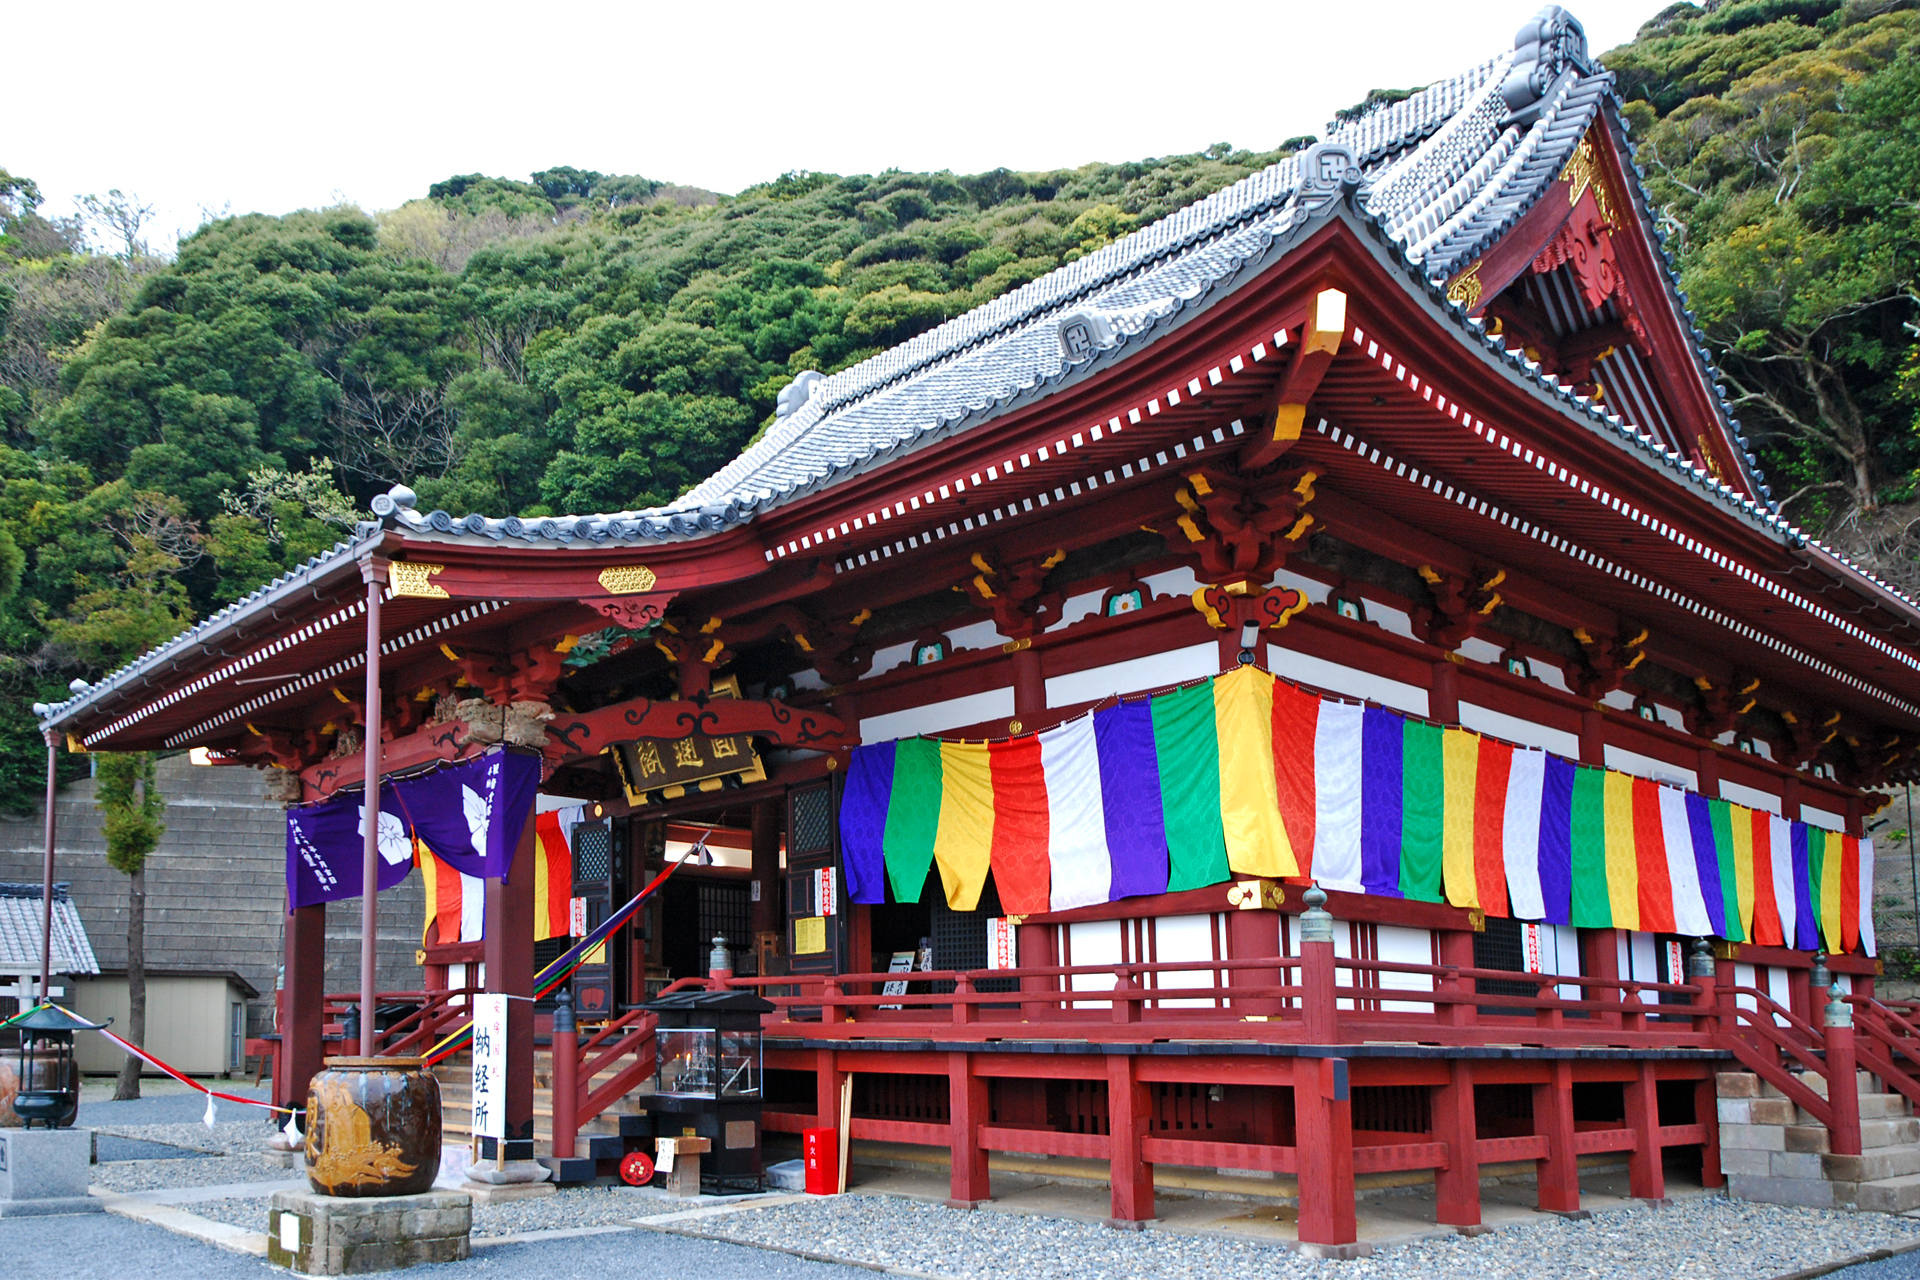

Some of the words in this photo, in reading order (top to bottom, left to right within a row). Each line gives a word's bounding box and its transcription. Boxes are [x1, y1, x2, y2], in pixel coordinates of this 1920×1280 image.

[474, 1026, 490, 1132] 納経所
[809, 1134, 817, 1167] 消火器
